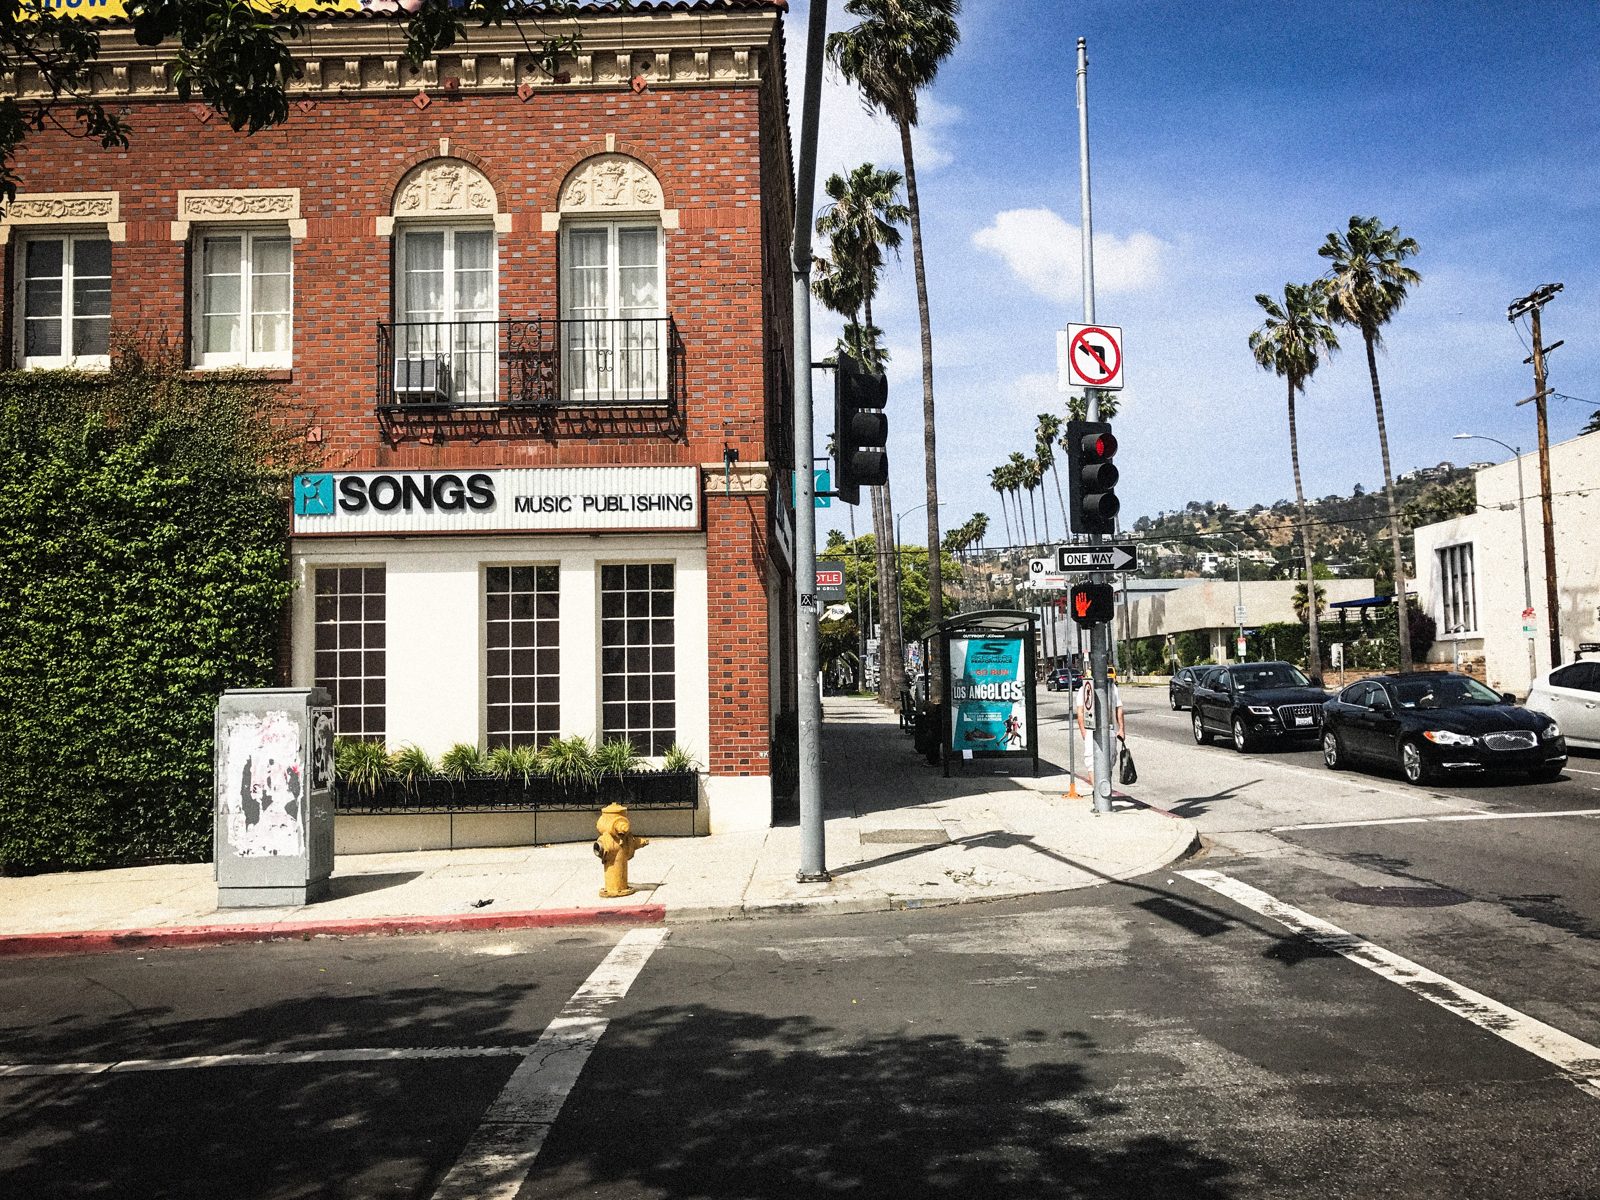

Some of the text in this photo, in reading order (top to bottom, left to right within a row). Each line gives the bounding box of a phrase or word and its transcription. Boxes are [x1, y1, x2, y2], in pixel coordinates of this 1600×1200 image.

[338, 474, 693, 513] SONGS MUSIC PUBLISHING
[1066, 553, 1113, 565] ONE WAY
[953, 686, 966, 699] LOS
